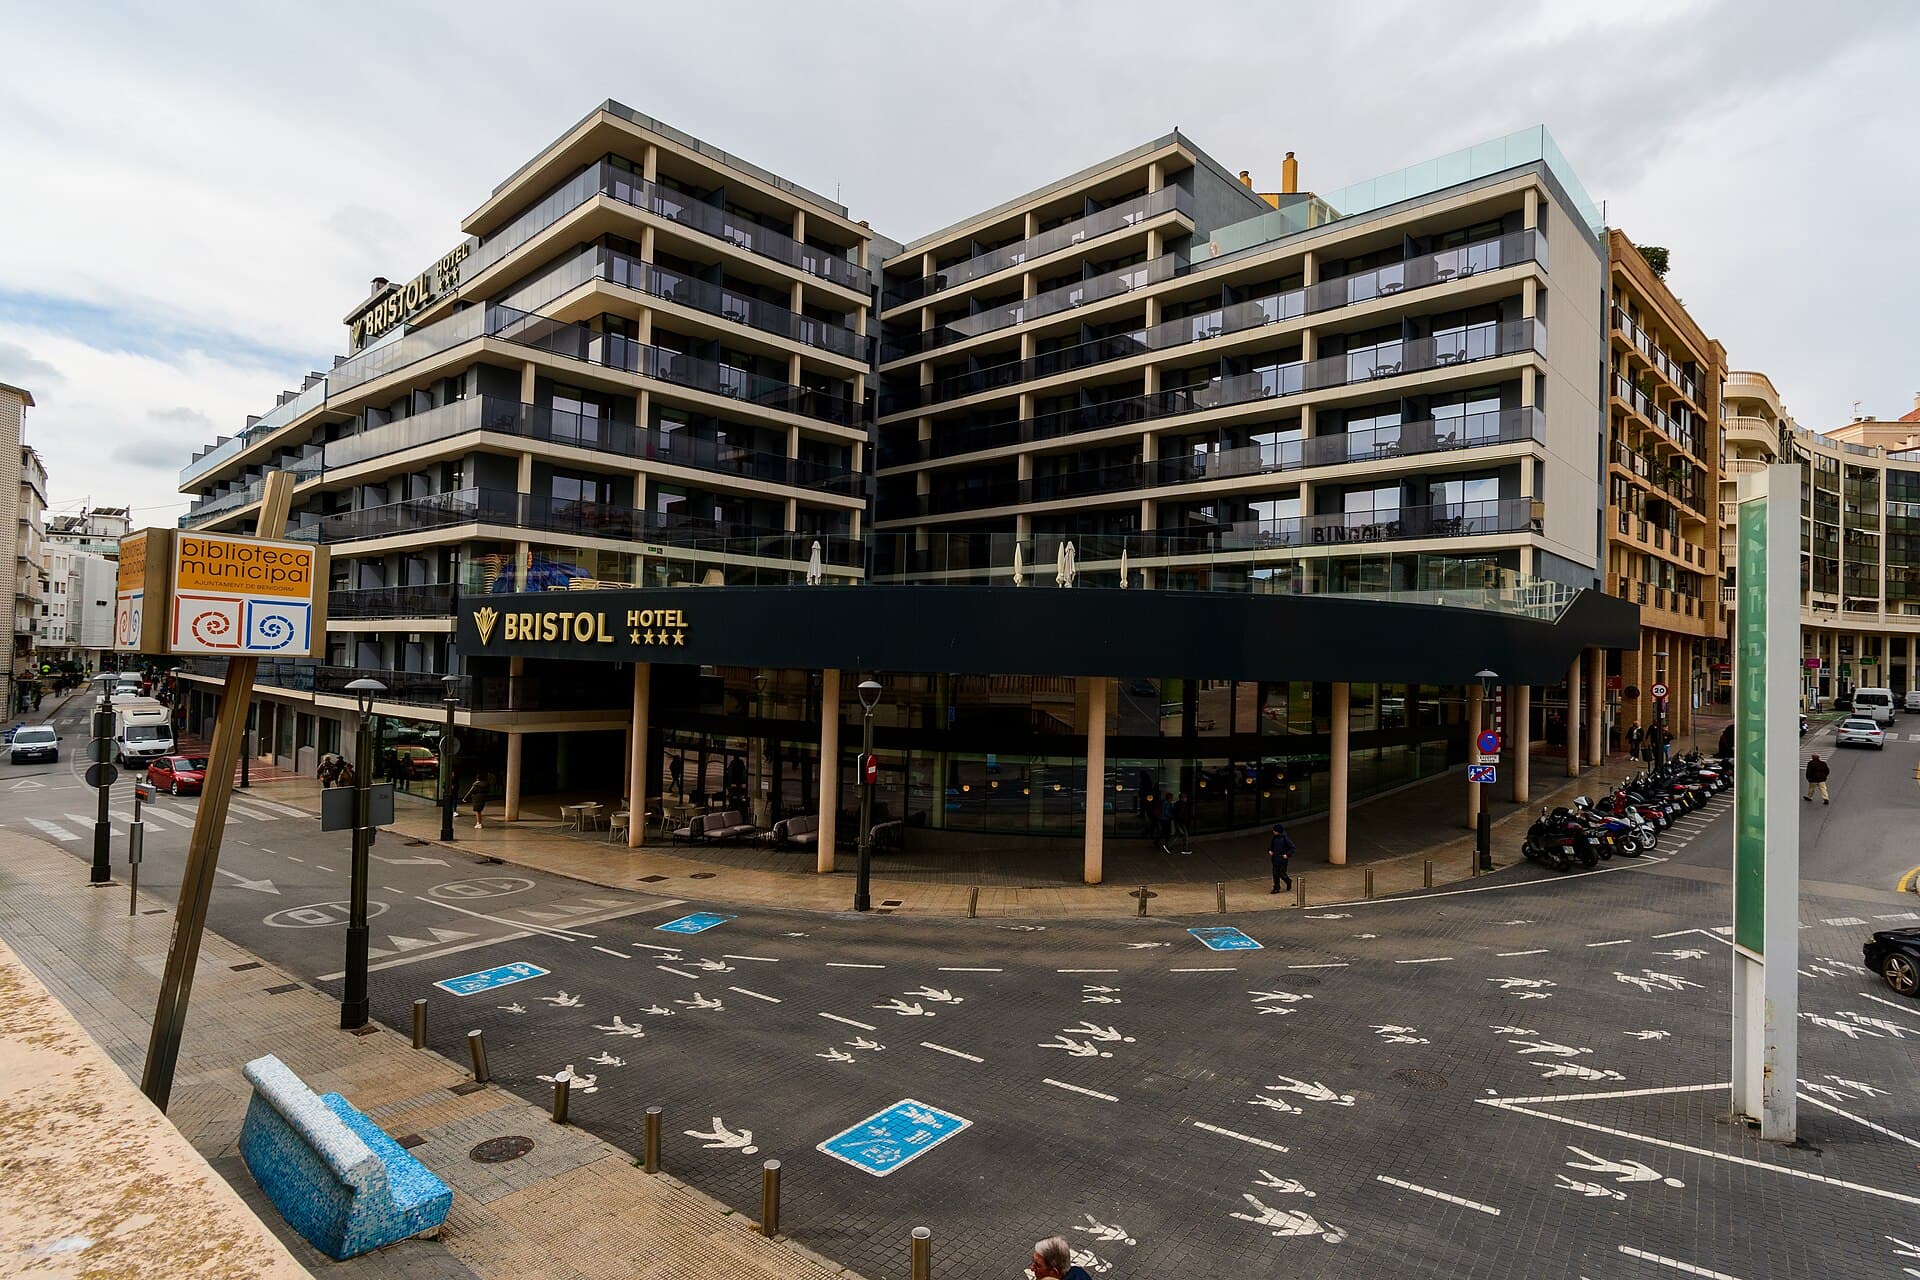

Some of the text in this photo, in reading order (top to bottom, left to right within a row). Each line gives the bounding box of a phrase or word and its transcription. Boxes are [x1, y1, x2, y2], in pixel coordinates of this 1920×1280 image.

[366, 244, 468, 336] BRISTOL HOTEL
[182, 539, 309, 567] biblioteca
[181, 560, 308, 583] municipal
[194, 580, 243, 590] AJUNTAMENT
[505, 610, 689, 643] BRISTOL HOTEL
